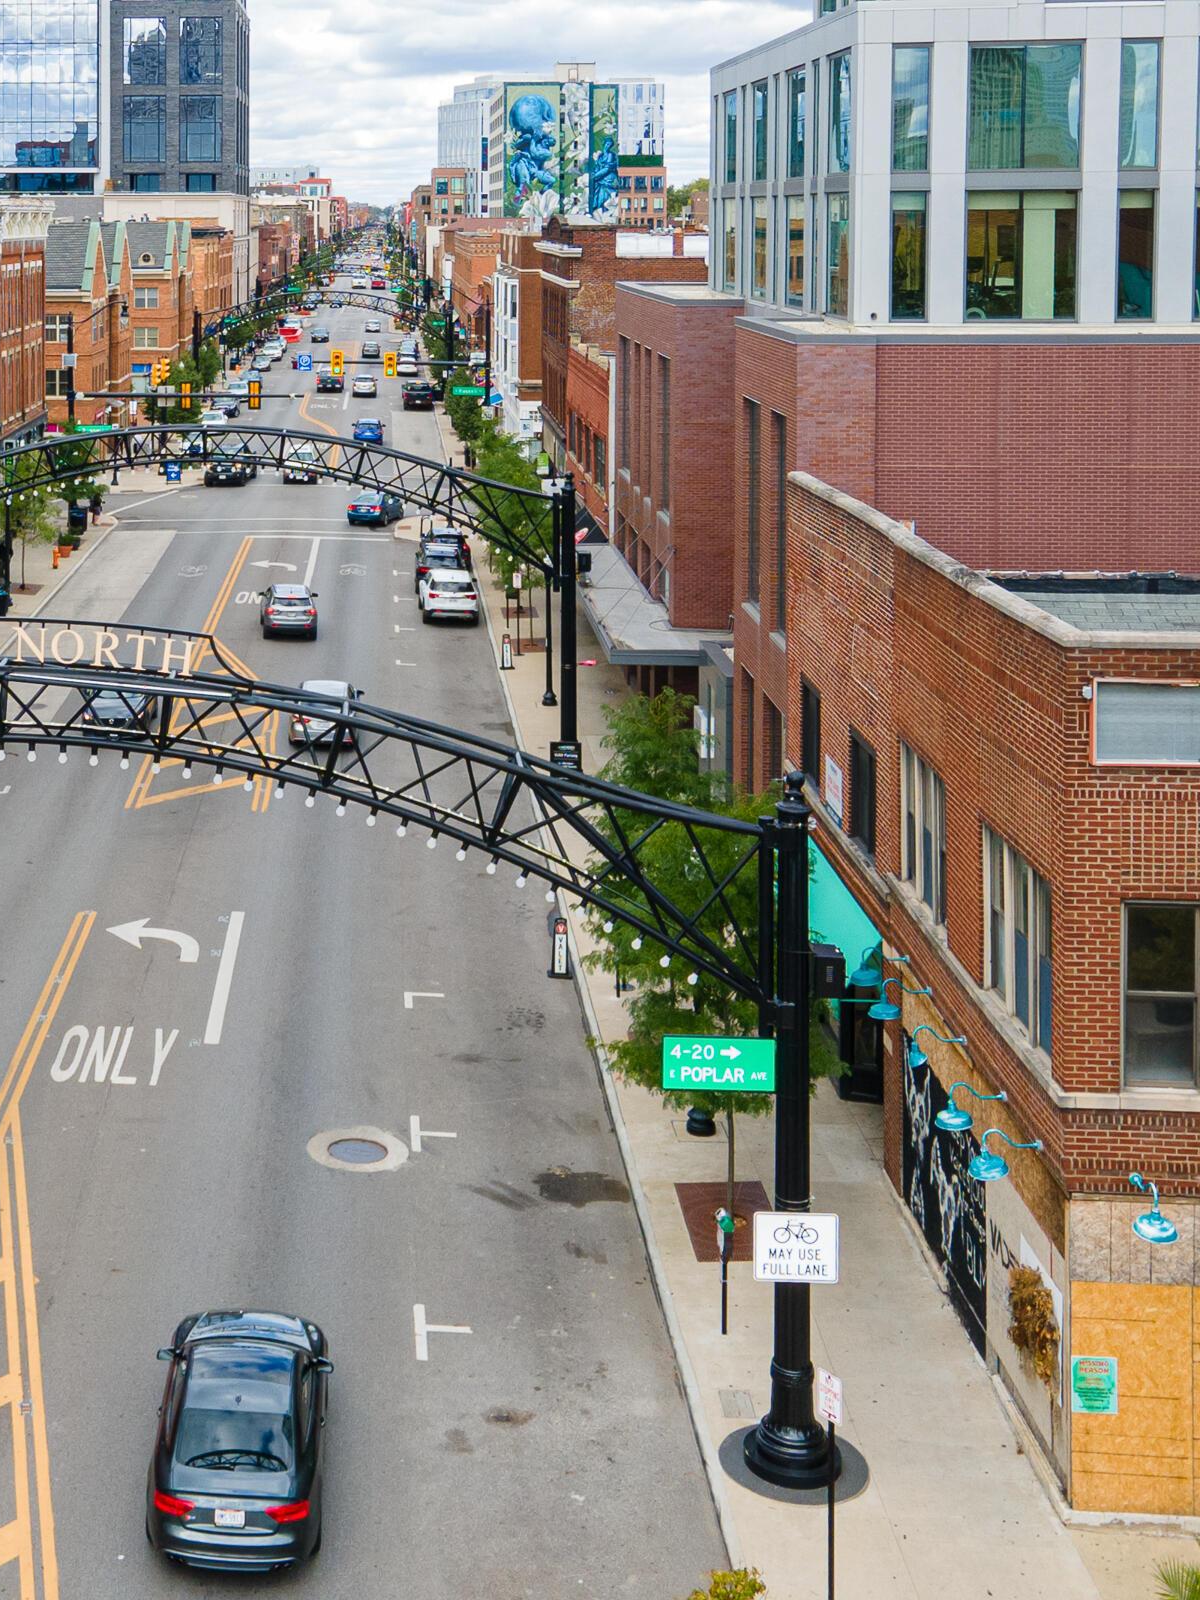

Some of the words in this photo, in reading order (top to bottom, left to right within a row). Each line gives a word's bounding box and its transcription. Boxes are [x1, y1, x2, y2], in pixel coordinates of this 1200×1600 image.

[13, 625, 198, 678] NORTH
[50, 1024, 180, 1086] ONLY
[669, 1044, 715, 1061] 4-20
[669, 1070, 675, 1079] E
[680, 1066, 745, 1084] POPLAR
[750, 1072, 768, 1082] AVE
[768, 1248, 794, 1261] MAY
[798, 1248, 821, 1261] USE
[762, 1263, 793, 1276] FULL
[797, 1263, 828, 1277] LANE
